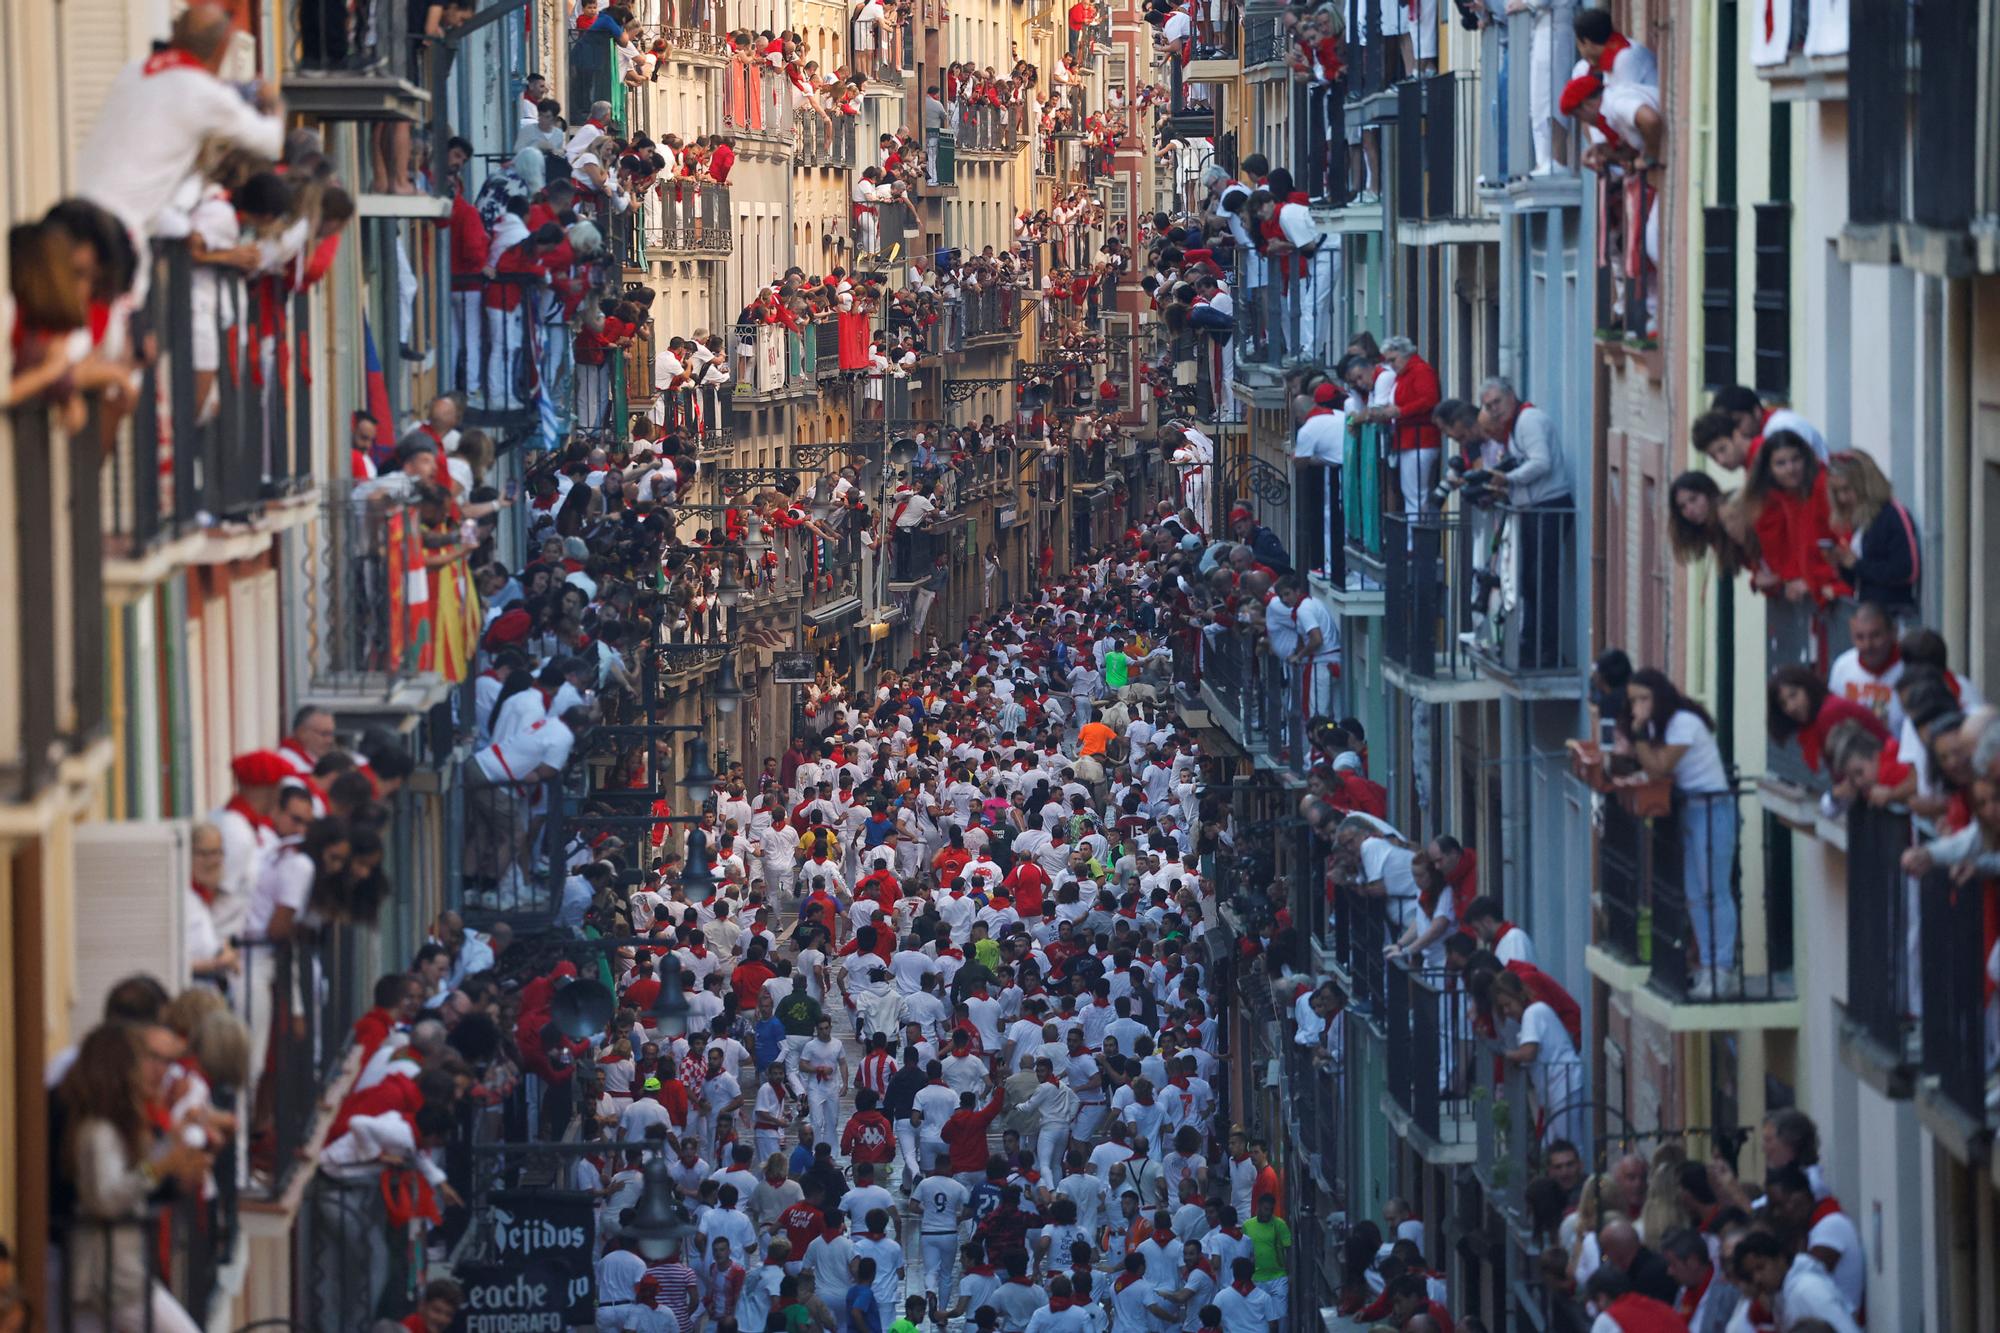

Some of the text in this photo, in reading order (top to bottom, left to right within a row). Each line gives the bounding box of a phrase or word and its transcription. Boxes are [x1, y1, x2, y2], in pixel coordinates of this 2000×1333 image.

[1130, 824, 1143, 839] 15
[908, 902, 919, 916] 7
[1180, 1094, 1193, 1119] 7
[934, 1192, 948, 1213] 9
[494, 1207, 586, 1255] Tejidos
[459, 1274, 548, 1310] eache
[466, 1312, 562, 1333] FOTOGRAFO
